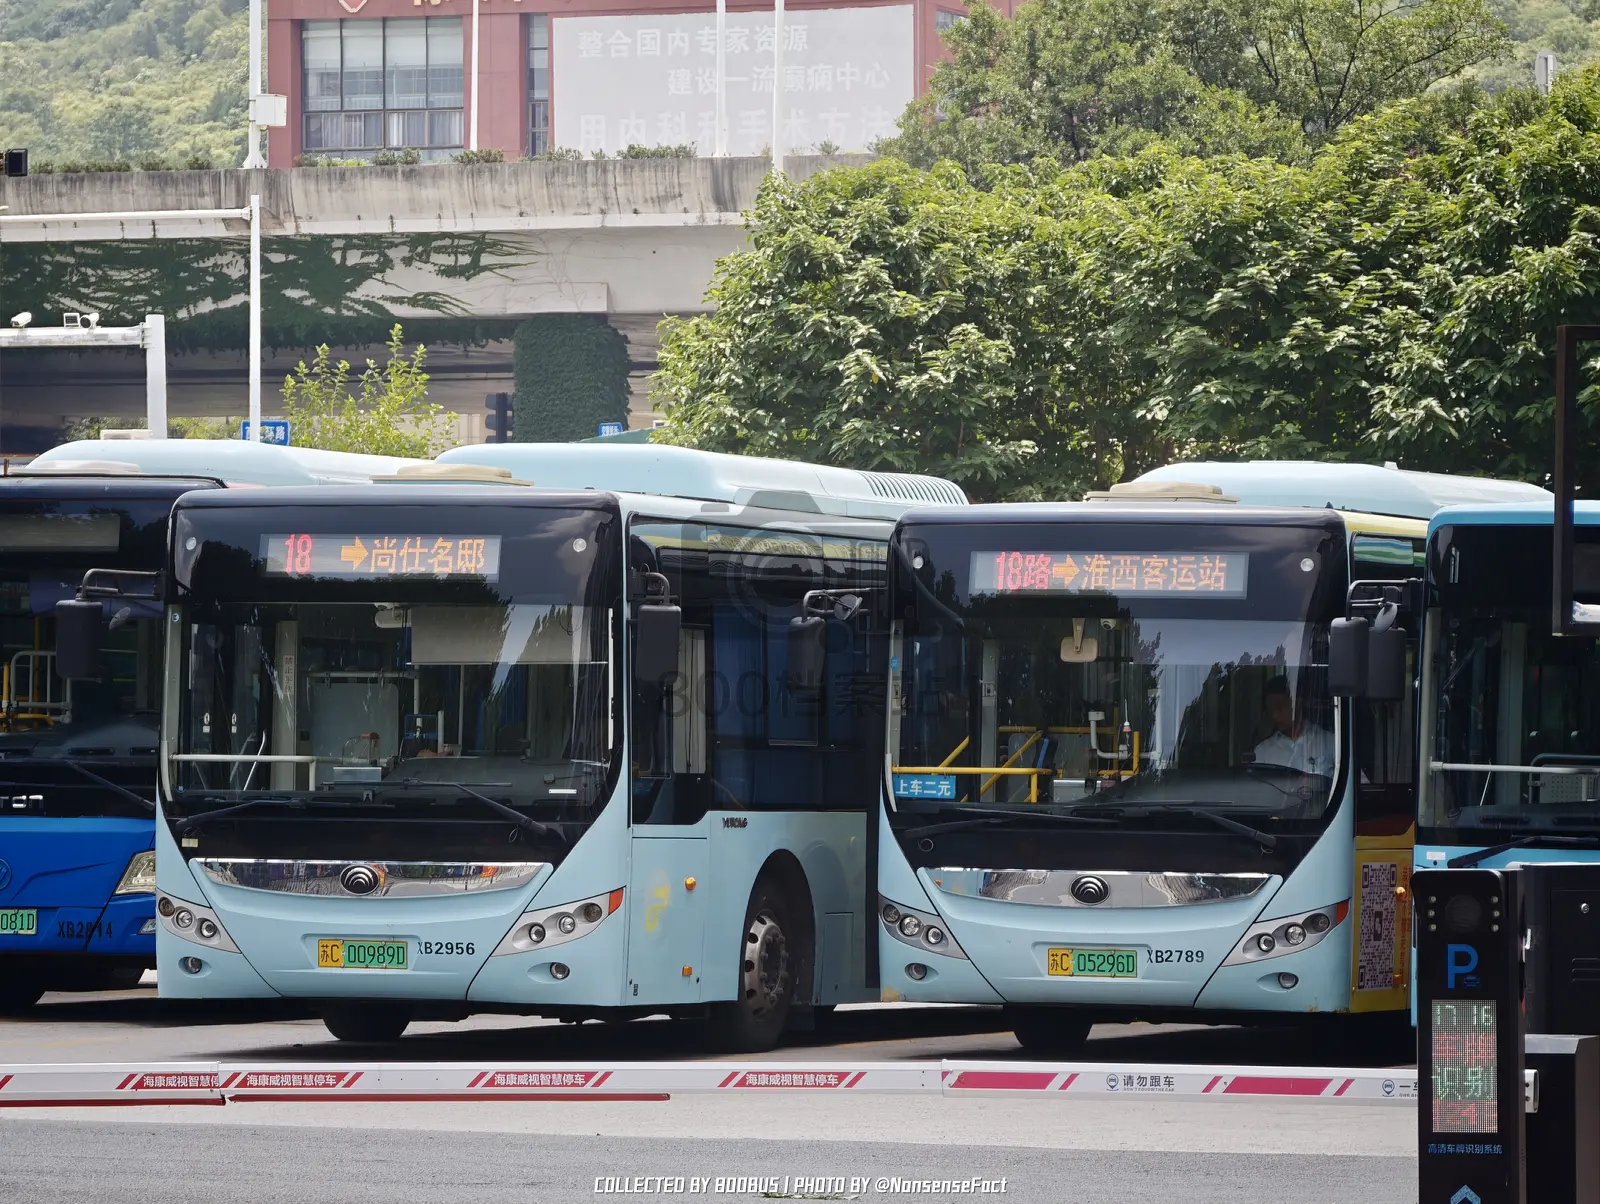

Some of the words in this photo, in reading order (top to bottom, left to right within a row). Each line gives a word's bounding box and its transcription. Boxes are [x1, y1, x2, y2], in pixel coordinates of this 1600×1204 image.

[284, 534, 313, 573] 18
[370, 537, 486, 573] 尚仕名邸
[995, 552, 1051, 590] 18路
[1081, 554, 1227, 591] 淮西客运站
[895, 779, 951, 796] 上车二元
[417, 941, 475, 955] XB2956
[1146, 949, 1204, 963] XB2789
[247, 1074, 337, 1086] 海康威视智慧停车
[494, 1073, 586, 1086] 海康威视智慧停车
[745, 1073, 839, 1086] 海康威视智慧停车
[1123, 1074, 1175, 1087] 请勿跟车
[1428, 1144, 1502, 1154] 高清车牌识别系统
